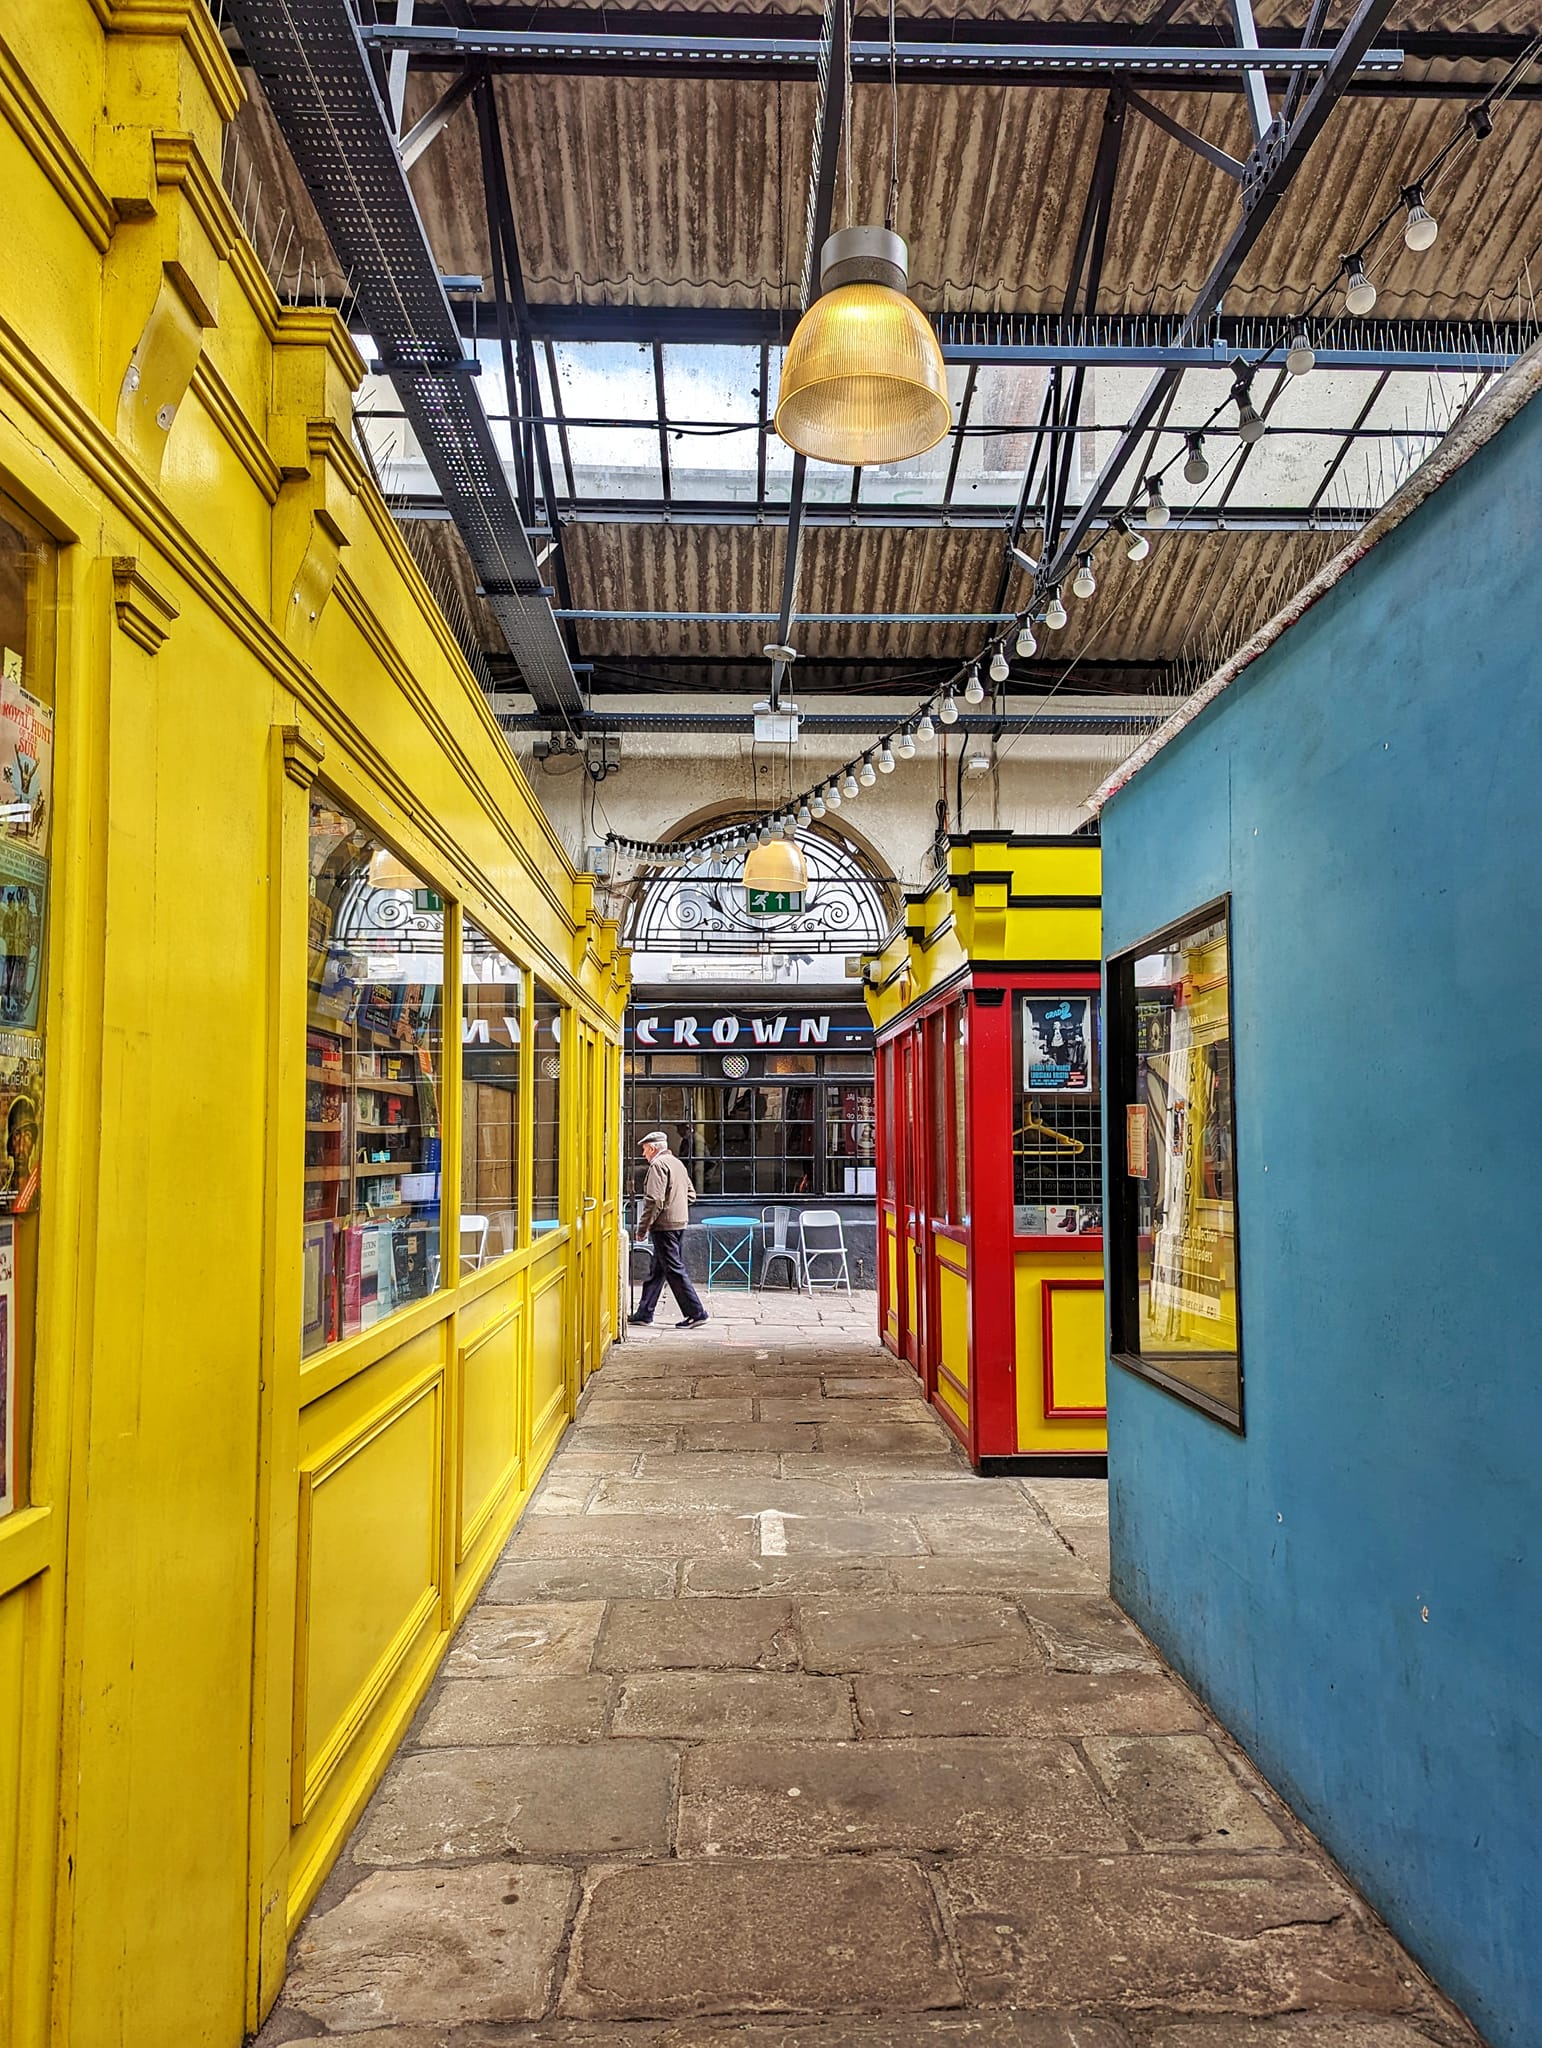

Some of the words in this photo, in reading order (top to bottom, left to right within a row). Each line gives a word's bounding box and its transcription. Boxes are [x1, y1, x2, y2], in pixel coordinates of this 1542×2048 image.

[2, 701, 30, 730] ROYAL
[31, 719, 51, 745] HUNT
[18, 738, 37, 760] SUN
[1059, 1001, 1073, 1020] 2
[636, 1015, 831, 1047] CROWN
[19, 1036, 41, 1060] MAILER
[1192, 1225, 1218, 1243] collection
[1194, 1247, 1213, 1263] traders
